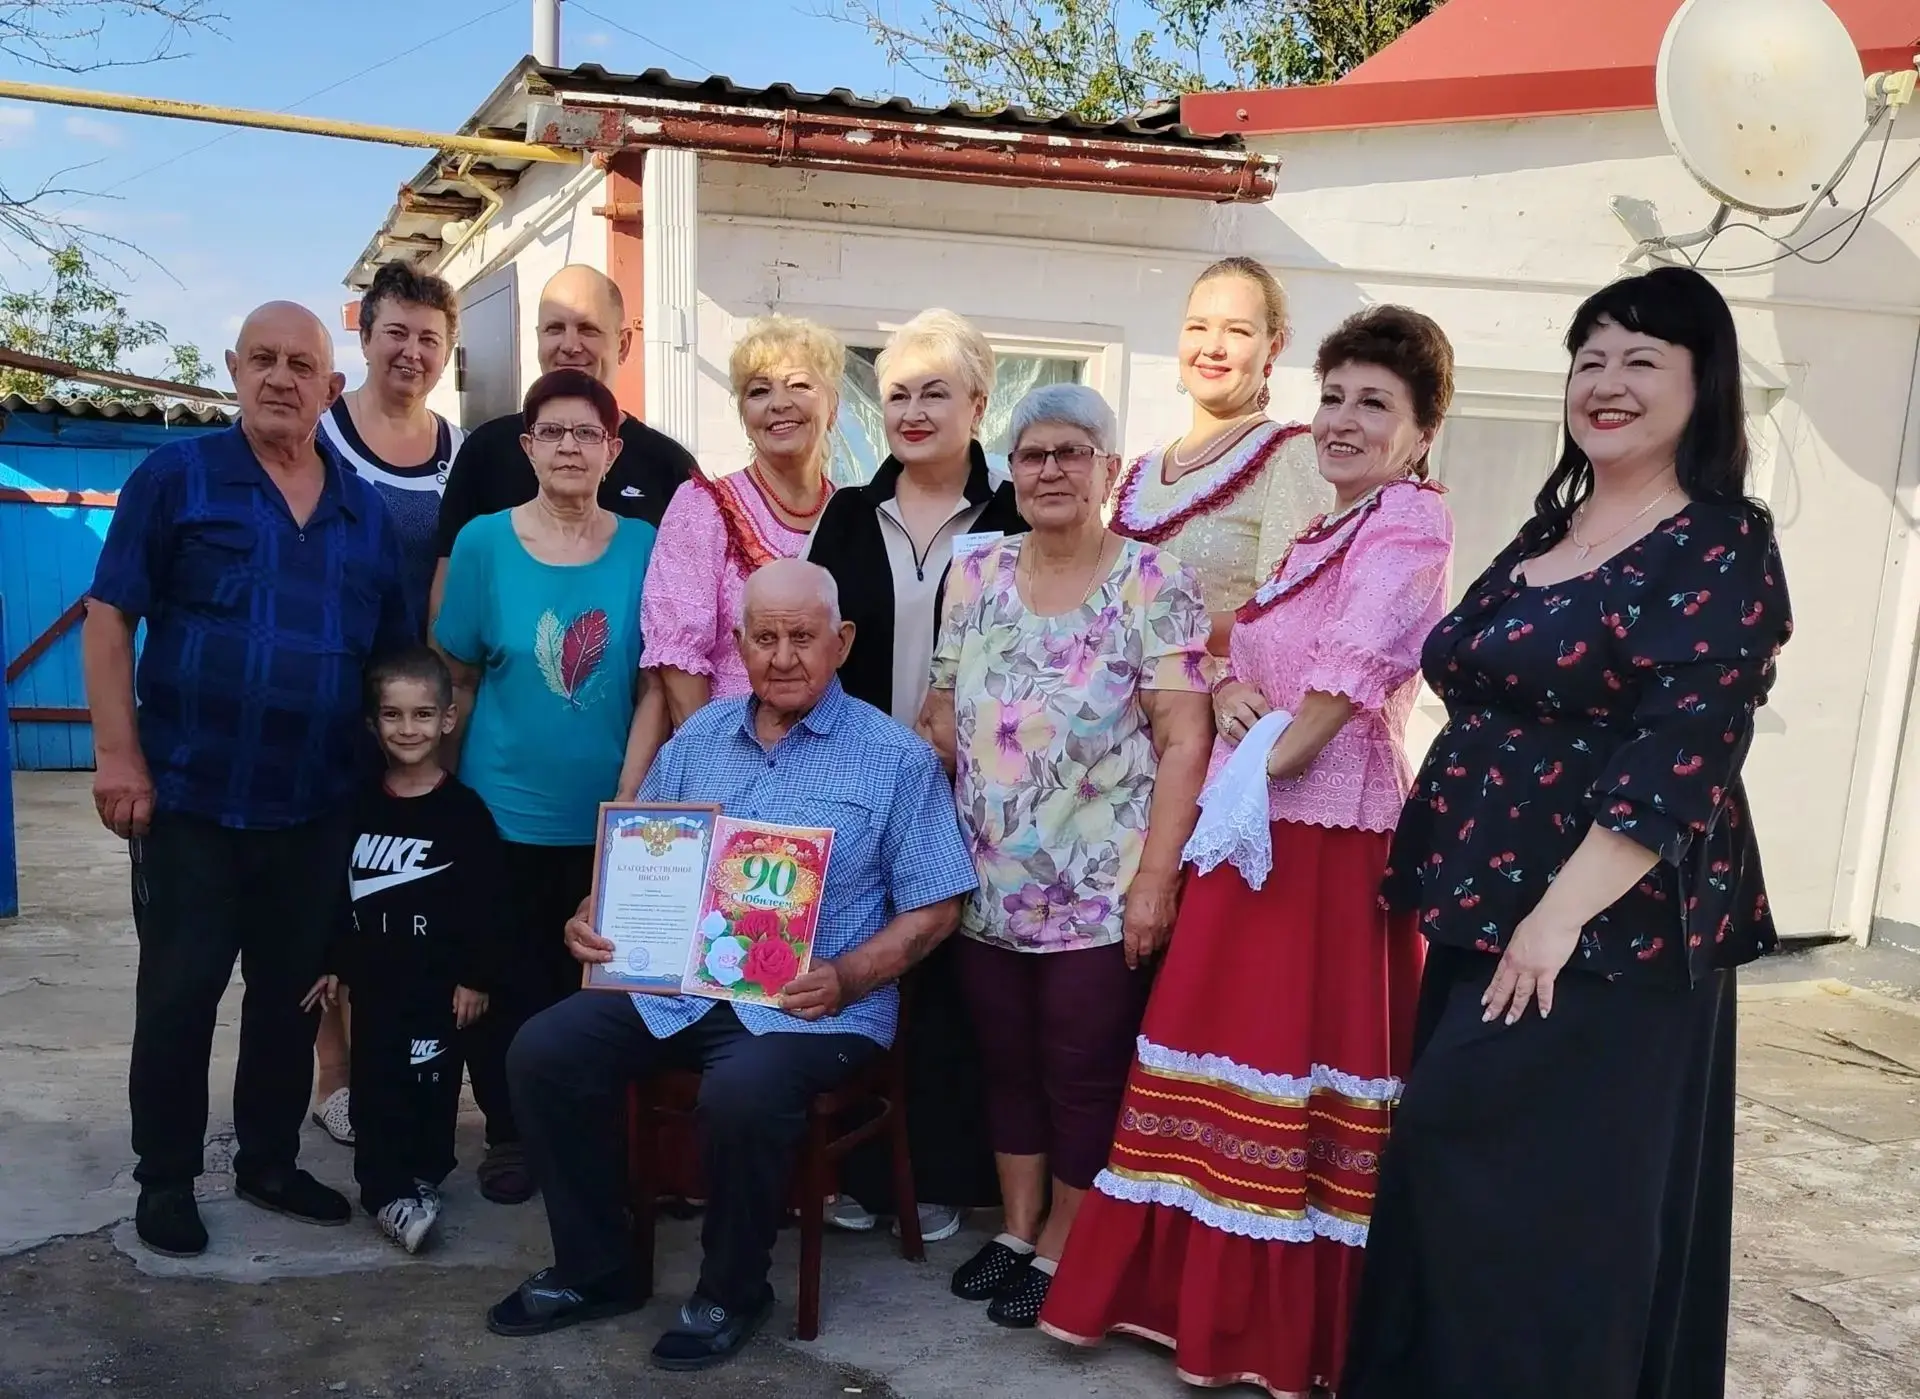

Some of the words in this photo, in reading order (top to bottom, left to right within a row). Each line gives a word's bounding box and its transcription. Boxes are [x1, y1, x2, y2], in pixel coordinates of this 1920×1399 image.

[352, 833, 433, 872] NIKE
[743, 855, 797, 897] 90
[411, 1039, 440, 1056] IKE
